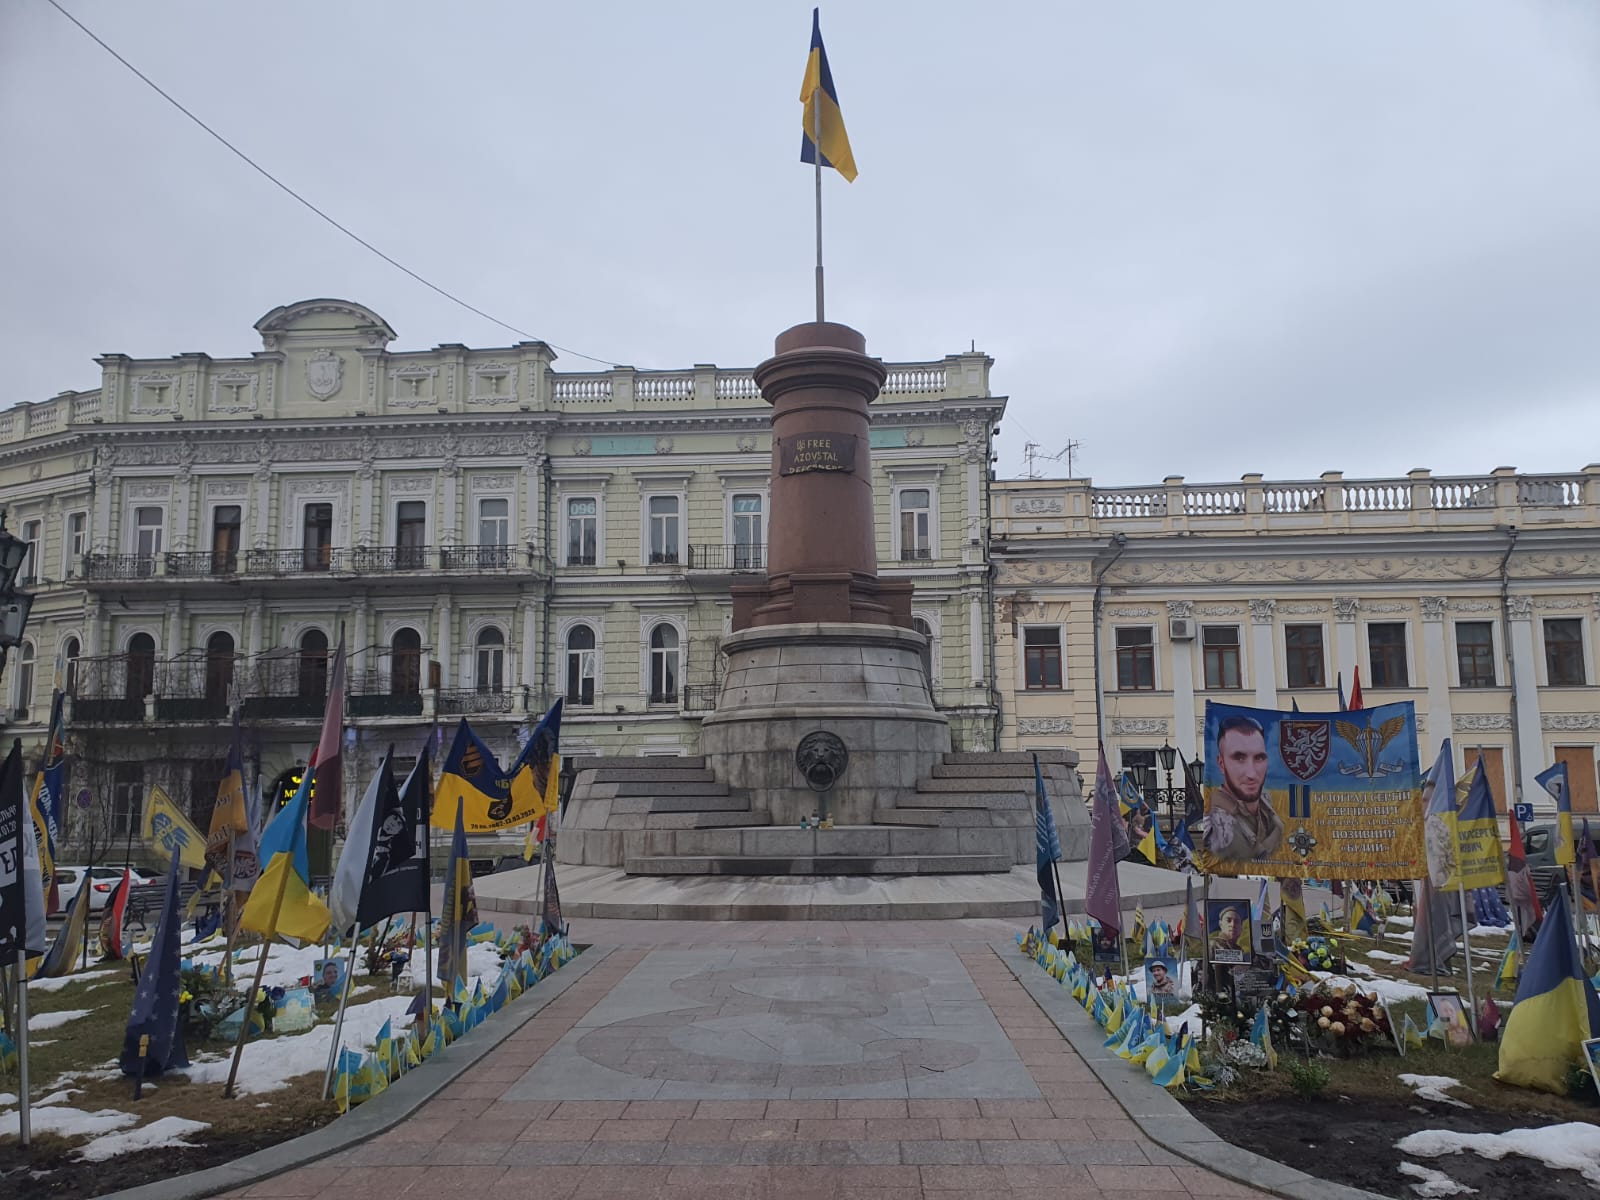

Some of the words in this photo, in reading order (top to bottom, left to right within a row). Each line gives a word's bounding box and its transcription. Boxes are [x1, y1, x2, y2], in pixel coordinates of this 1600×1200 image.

[807, 439, 831, 449] FREE
[793, 451, 839, 463] AZOVSTAL
[570, 503, 596, 515] 096
[739, 499, 758, 511] 77
[1370, 791, 1411, 802] СЕРГІЙ
[1327, 806, 1399, 816] СЕРГІЙОВИЧ
[1516, 805, 1527, 819] P
[1332, 829, 1396, 840] ПОЗИВНИЙ
